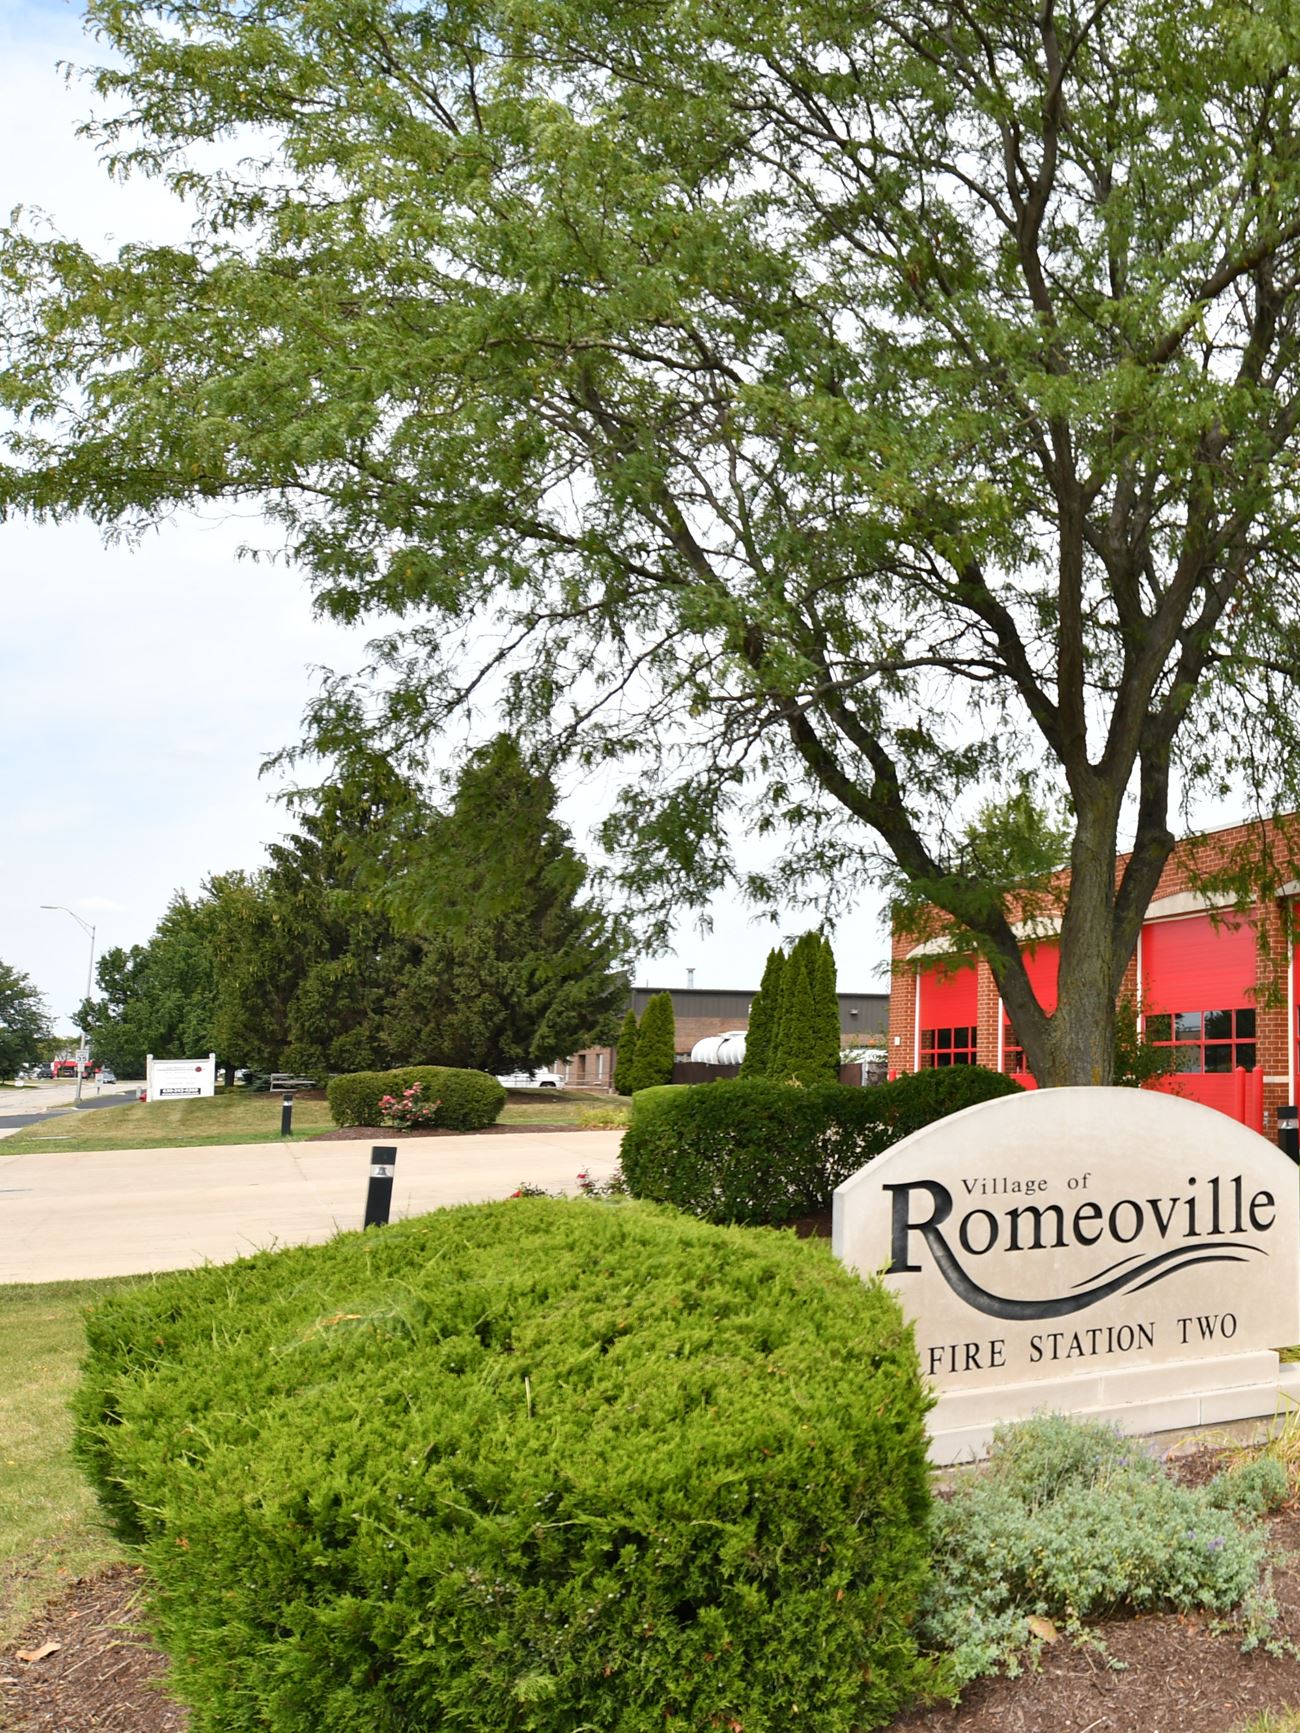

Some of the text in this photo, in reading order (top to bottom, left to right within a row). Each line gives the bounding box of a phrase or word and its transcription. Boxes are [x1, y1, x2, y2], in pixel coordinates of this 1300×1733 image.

[961, 1172, 1092, 1196] Village of
[876, 1175, 1277, 1277] Romeoville
[927, 1312, 1238, 1376] FIRE STATION TWO
